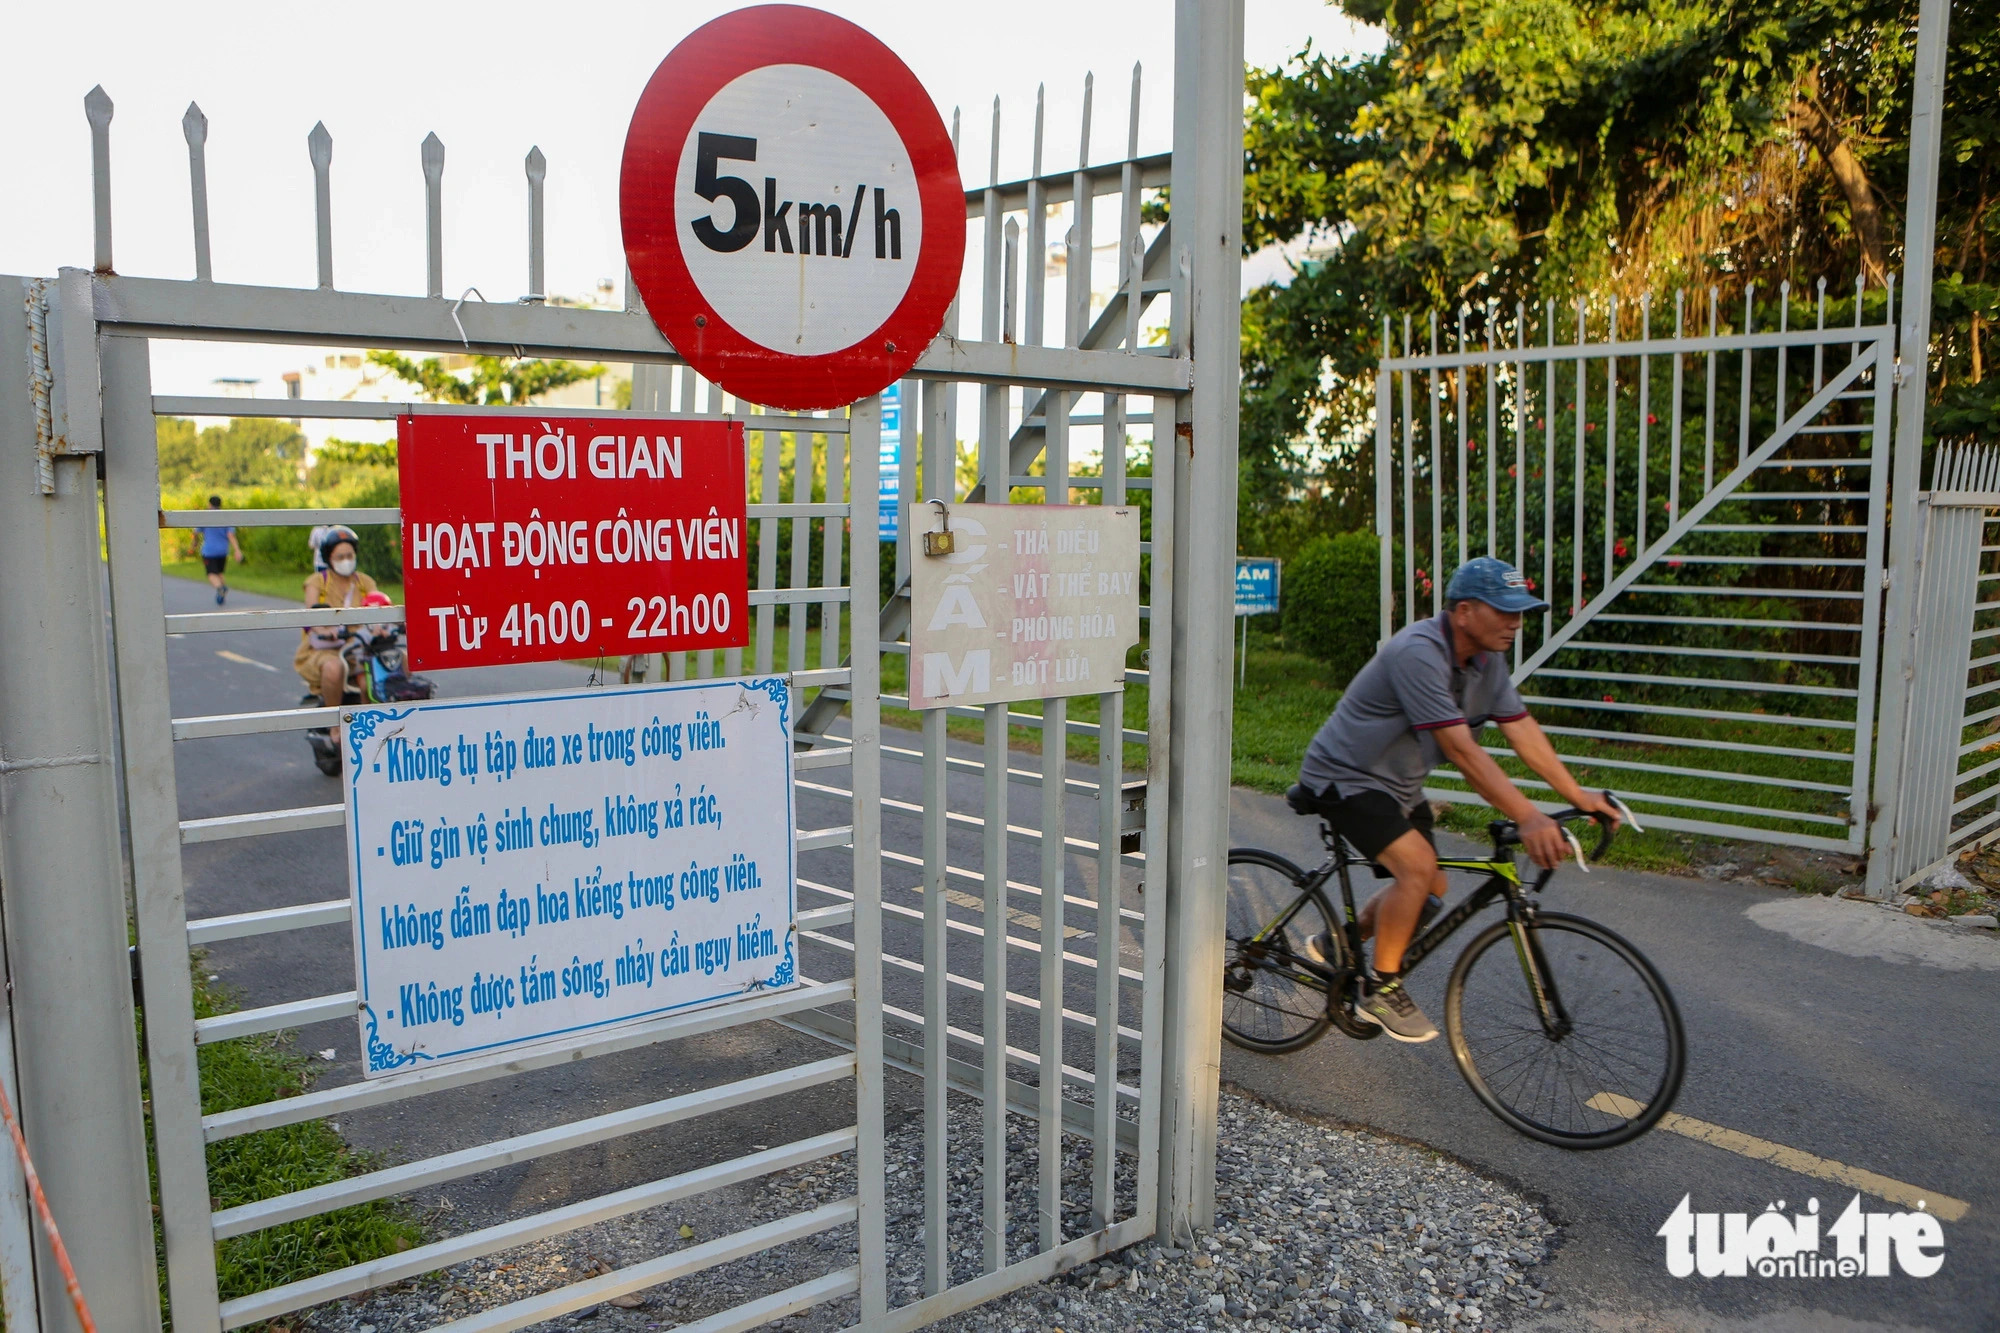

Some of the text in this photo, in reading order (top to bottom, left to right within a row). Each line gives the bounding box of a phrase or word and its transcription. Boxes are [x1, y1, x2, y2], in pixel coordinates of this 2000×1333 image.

[691, 131, 901, 260] 5km/h
[476, 421, 682, 480] THỜI GIAN
[412, 506, 738, 579] HOẠT ĐỘNG CÔNG VIÊN
[1014, 521, 1049, 555] THẢ
[1013, 569, 1050, 604] VẬT
[1057, 561, 1091, 597] THỂ
[1098, 571, 1133, 596] BAY
[429, 604, 487, 651] Từ
[500, 600, 590, 647] 4h00
[627, 592, 730, 639] 22h00
[1012, 652, 1049, 687] ĐỐT
[387, 737, 452, 787] Không
[458, 734, 478, 784] tụ
[485, 730, 516, 783] tập
[524, 726, 556, 769] đua
[562, 733, 582, 765] xe
[588, 723, 635, 766] trong
[641, 716, 682, 761] công
[688, 711, 726, 751] viên.
[391, 818, 424, 866] Giữ
[430, 817, 460, 869] gìn
[466, 812, 488, 865] vệ
[495, 806, 533, 852] sinh
[540, 803, 599, 848] chung,
[605, 794, 658, 839] không
[664, 783, 683, 829] xả
[690, 785, 722, 830] rác,
[381, 853, 761, 950] không dẫm đạp hoa kiểng trong công viên.
[400, 981, 464, 1028] Không
[470, 972, 515, 1019] được
[520, 954, 556, 1006] tắm
[562, 956, 610, 998] sông,
[616, 938, 655, 988] nhảy
[661, 930, 690, 977] cầu
[695, 936, 731, 976] nguy
[737, 912, 778, 962] hiểm.
